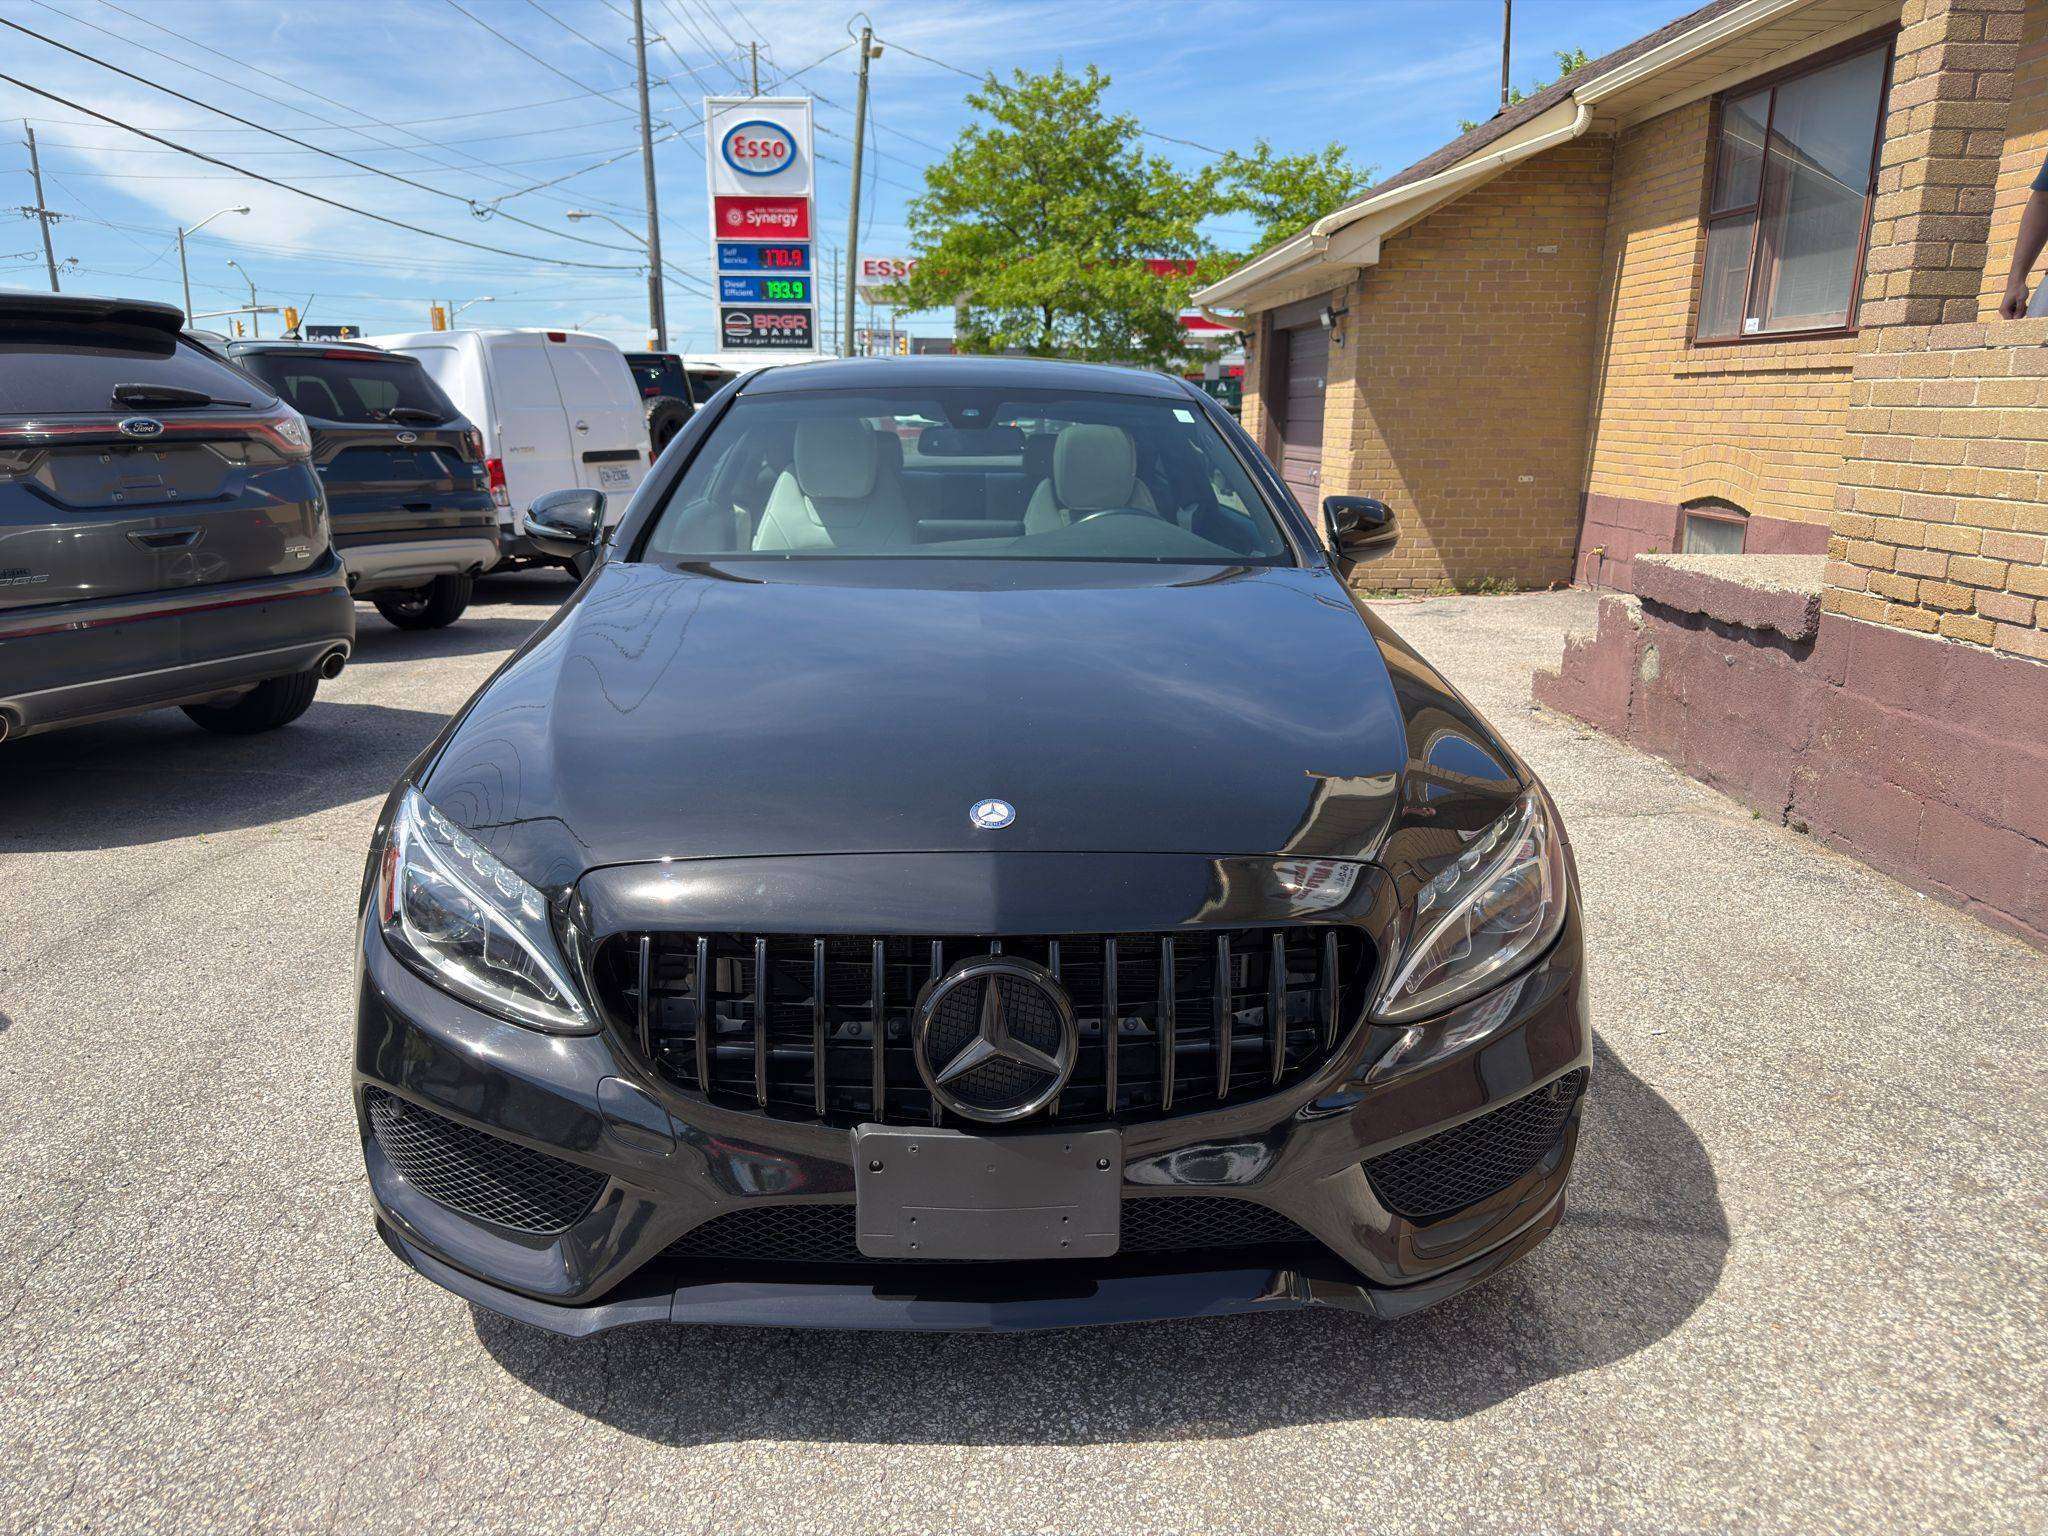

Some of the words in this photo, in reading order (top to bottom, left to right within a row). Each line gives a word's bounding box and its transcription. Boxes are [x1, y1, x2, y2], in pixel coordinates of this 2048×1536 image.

[746, 209, 798, 227] Synergy
[723, 280, 747, 288] Diesel
[767, 281, 804, 298] 193.9
[753, 314, 808, 329] BRGR
[759, 328, 803, 336] BARN
[132, 422, 156, 432] Ford
